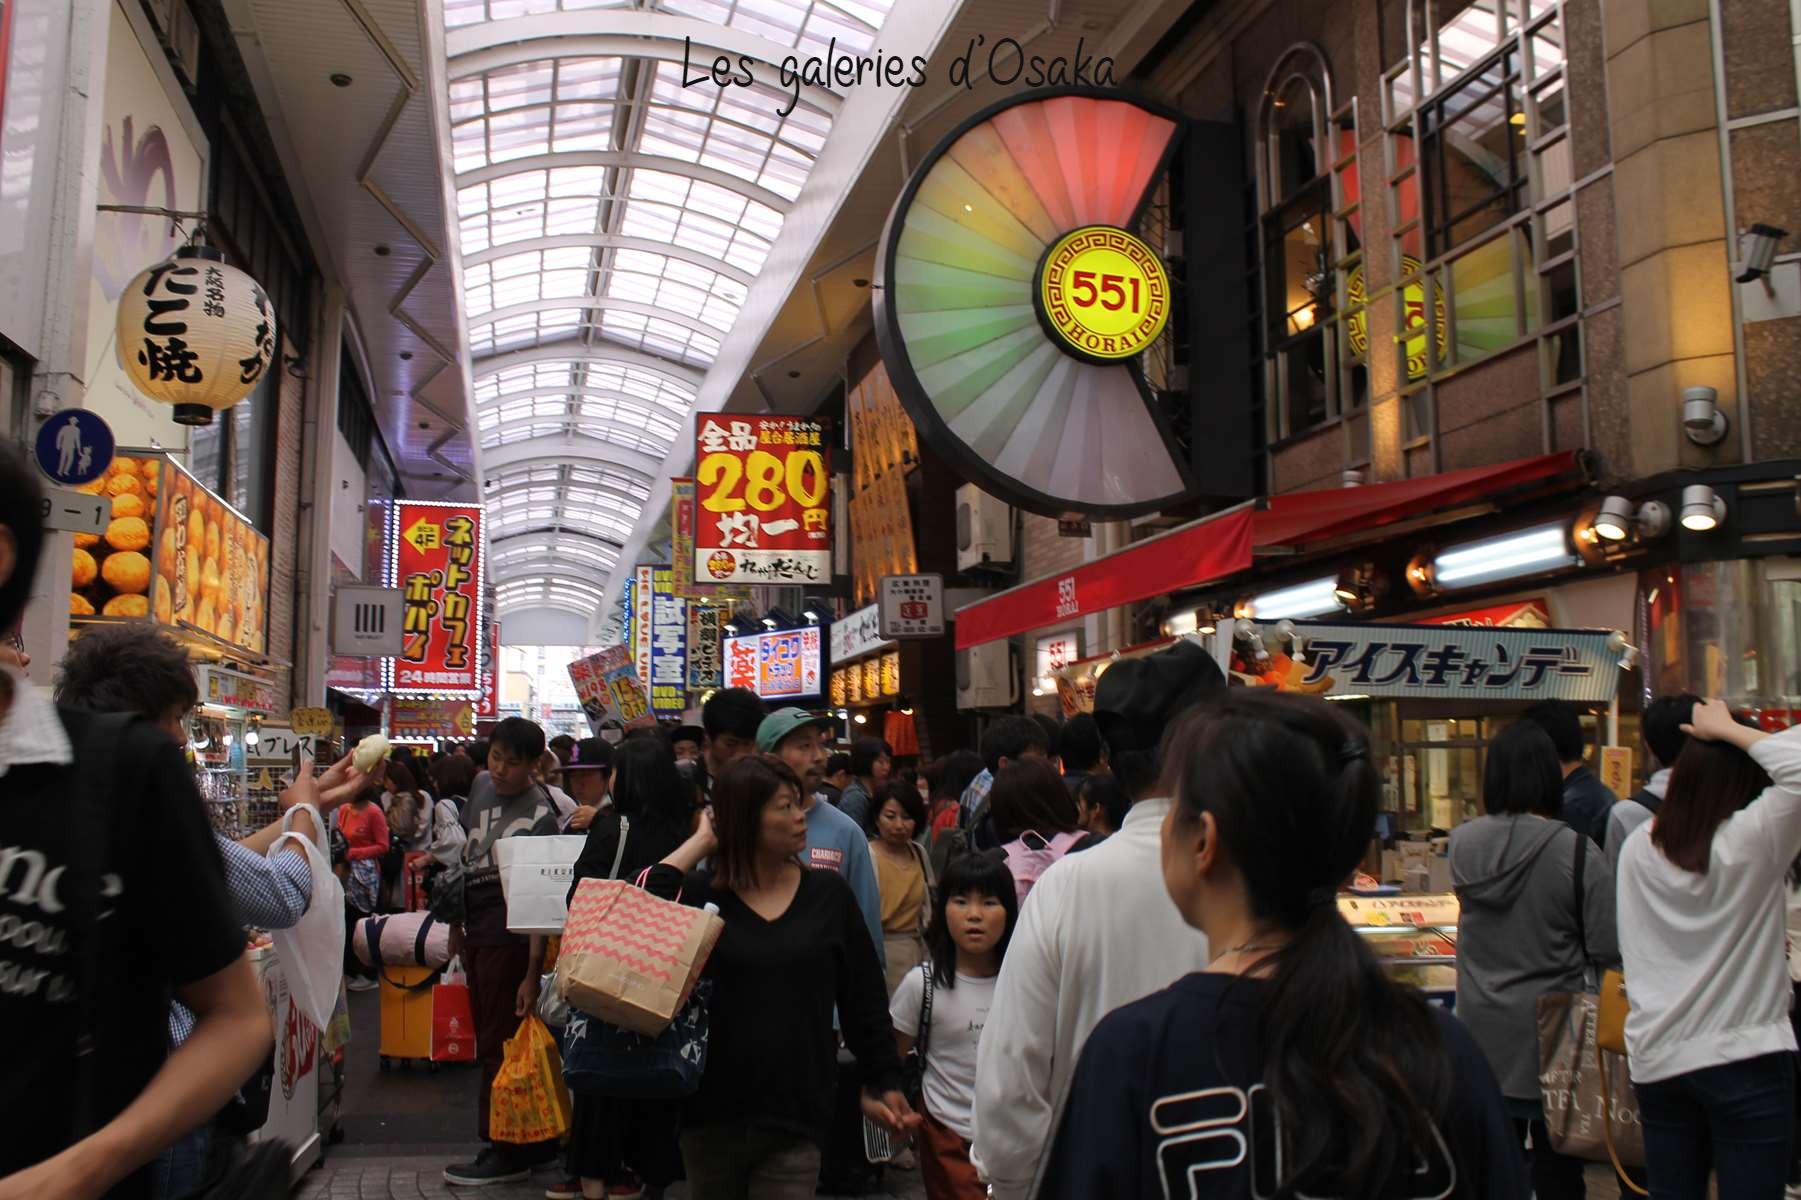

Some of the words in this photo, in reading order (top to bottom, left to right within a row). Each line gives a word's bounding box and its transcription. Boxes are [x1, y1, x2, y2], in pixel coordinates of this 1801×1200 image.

[1072, 270, 1140, 314] 551
[138, 262, 203, 384] たこ焼
[1067, 322, 1142, 353] HORAI
[698, 419, 759, 452] 全品
[697, 450, 828, 512] 280
[415, 534, 436, 547] 4F
[715, 511, 800, 548] 均一
[803, 508, 829, 531] 円
[444, 516, 475, 670] ネットカフェ
[653, 597, 686, 684] 試写室
[1305, 639, 1592, 688] アイスキャンデー
